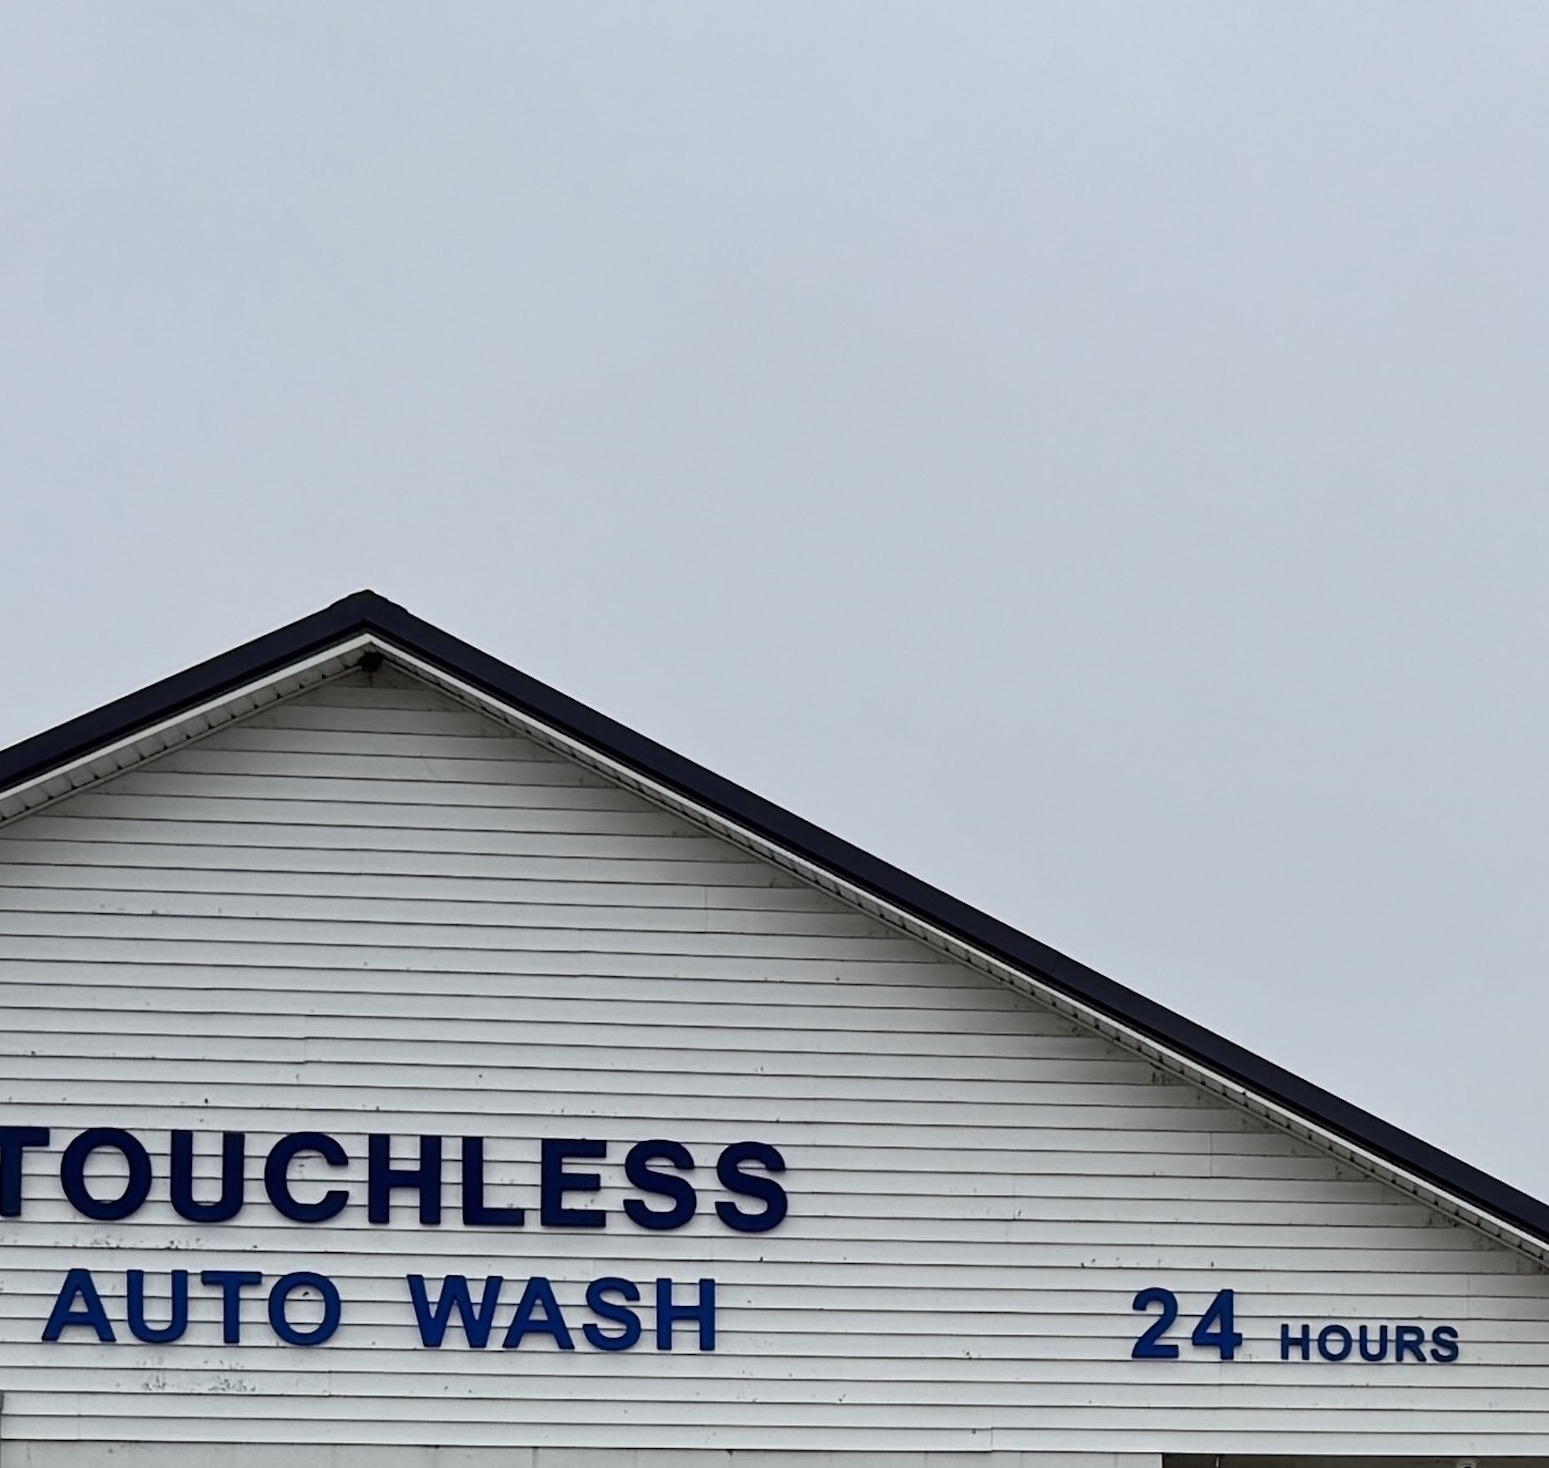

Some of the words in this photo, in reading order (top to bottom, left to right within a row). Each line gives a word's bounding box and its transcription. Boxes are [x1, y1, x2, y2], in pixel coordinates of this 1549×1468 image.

[41, 1266, 345, 1349] AUTO
[406, 1273, 720, 1354] WASH
[1130, 1286, 1246, 1362] 24
[1278, 1323, 1462, 1364] HOURS
